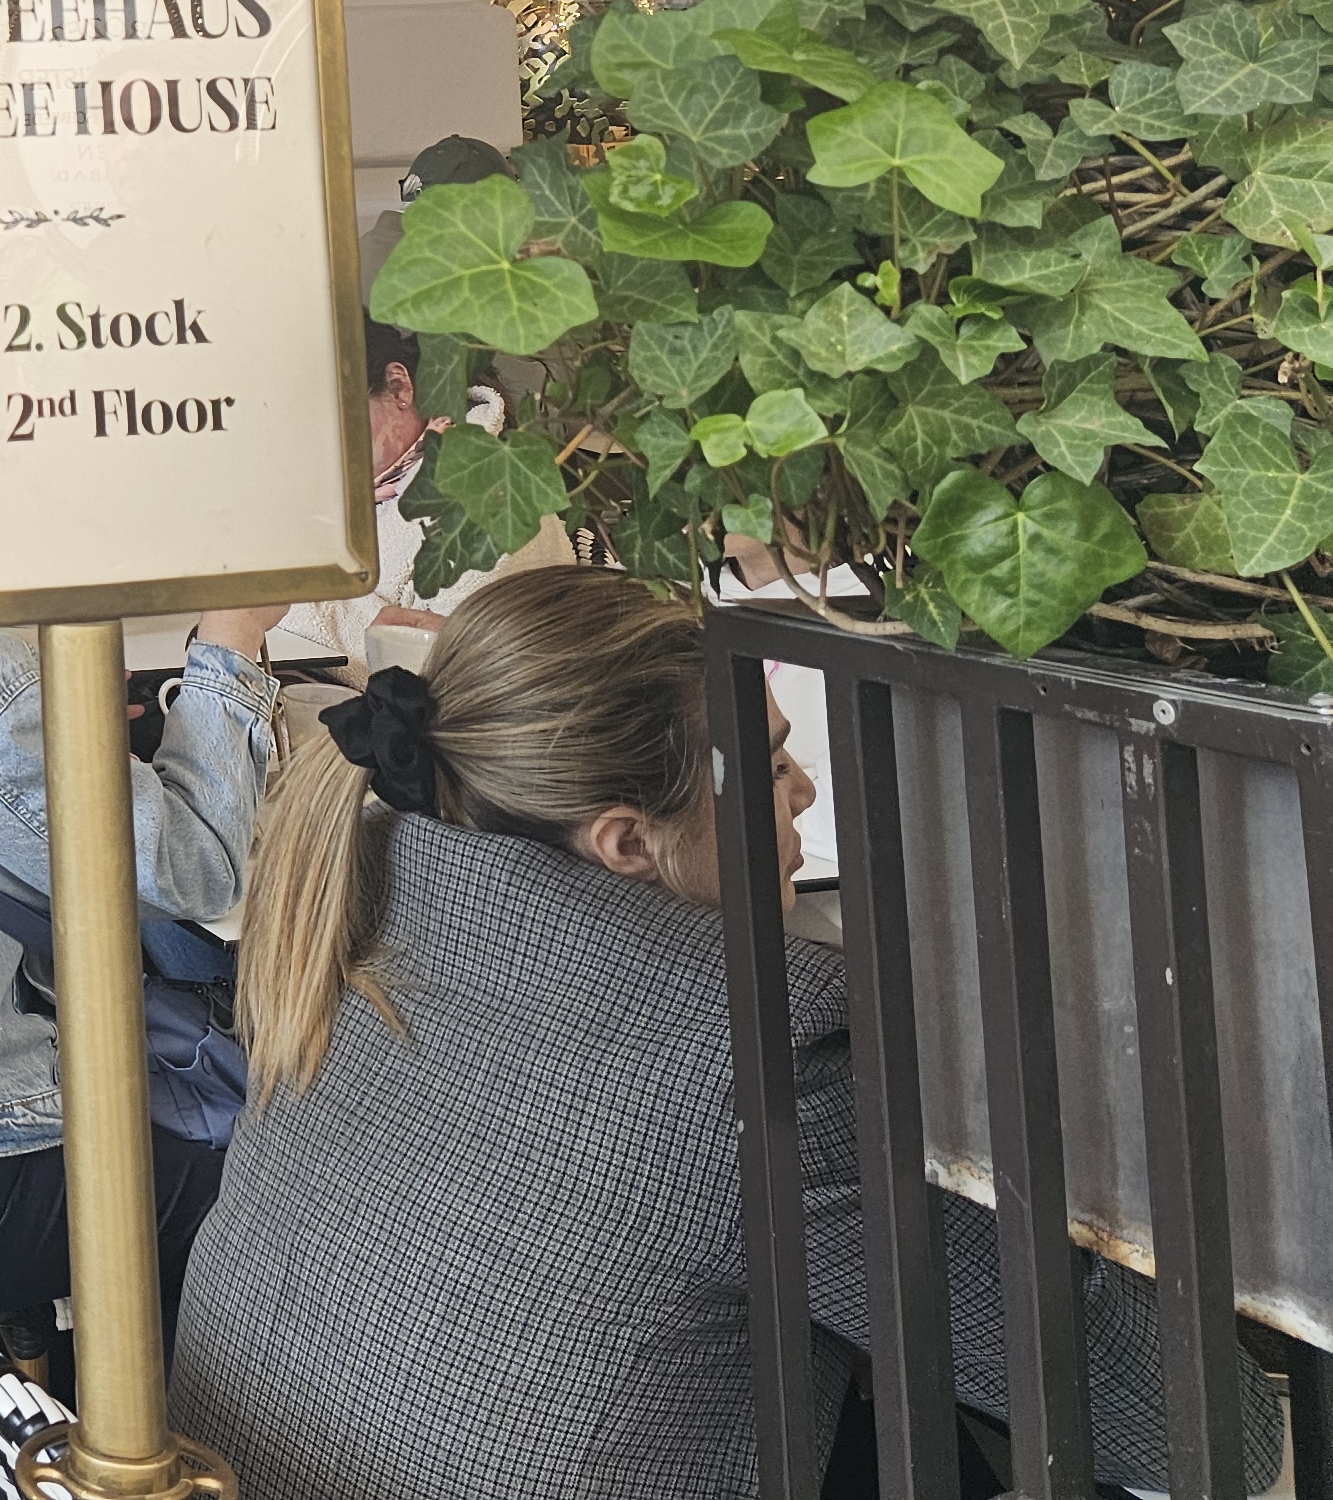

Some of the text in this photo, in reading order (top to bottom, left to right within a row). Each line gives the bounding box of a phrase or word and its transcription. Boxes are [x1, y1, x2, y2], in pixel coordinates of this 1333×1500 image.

[74, 76, 278, 137] HOUSE
[3, 302, 44, 353] 2.
[55, 297, 213, 351] Stock
[6, 388, 78, 442] 2nd
[90, 387, 236, 438] Floor
